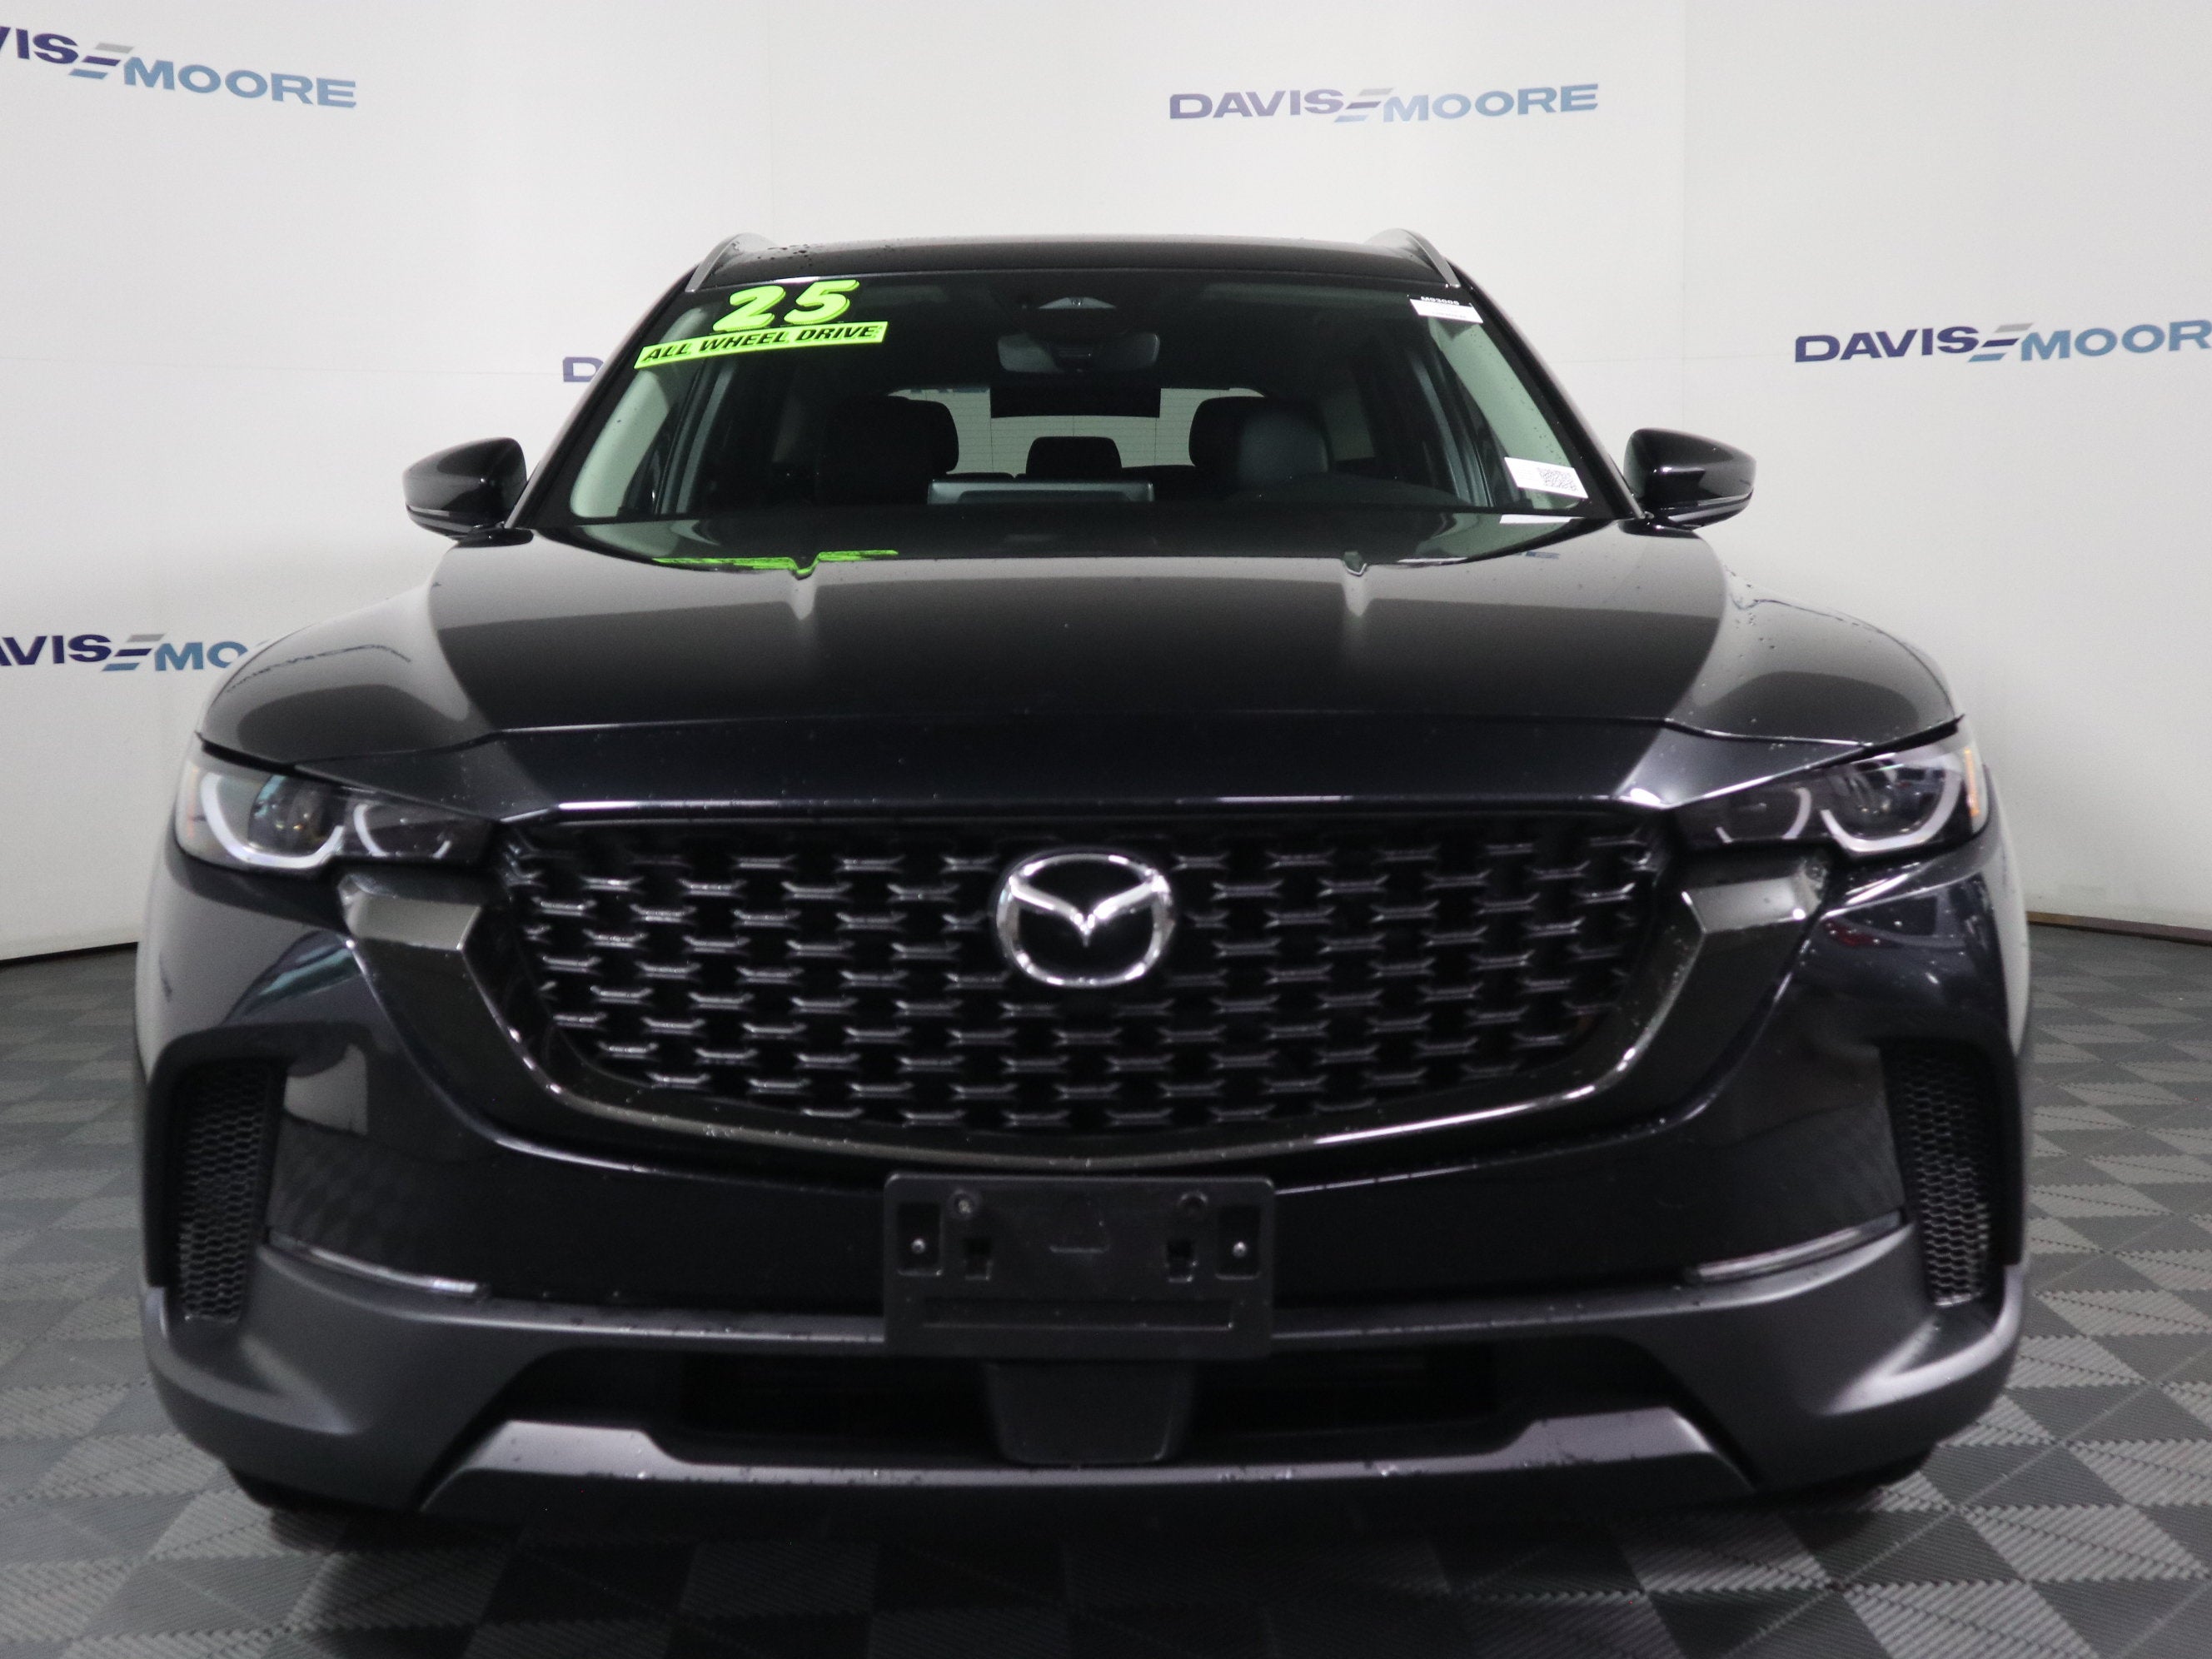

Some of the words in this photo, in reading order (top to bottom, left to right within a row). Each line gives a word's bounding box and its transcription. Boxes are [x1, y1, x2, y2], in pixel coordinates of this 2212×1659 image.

[123, 57, 357, 108] MOORE
[1169, 88, 1344, 120] DAVIS
[1382, 83, 1598, 122] MOORE
[712, 279, 859, 332] 25
[642, 342, 688, 361] ALL
[699, 331, 787, 352] WHEEL
[795, 324, 881, 341] DRIVE
[1795, 326, 1980, 362] DAVIS
